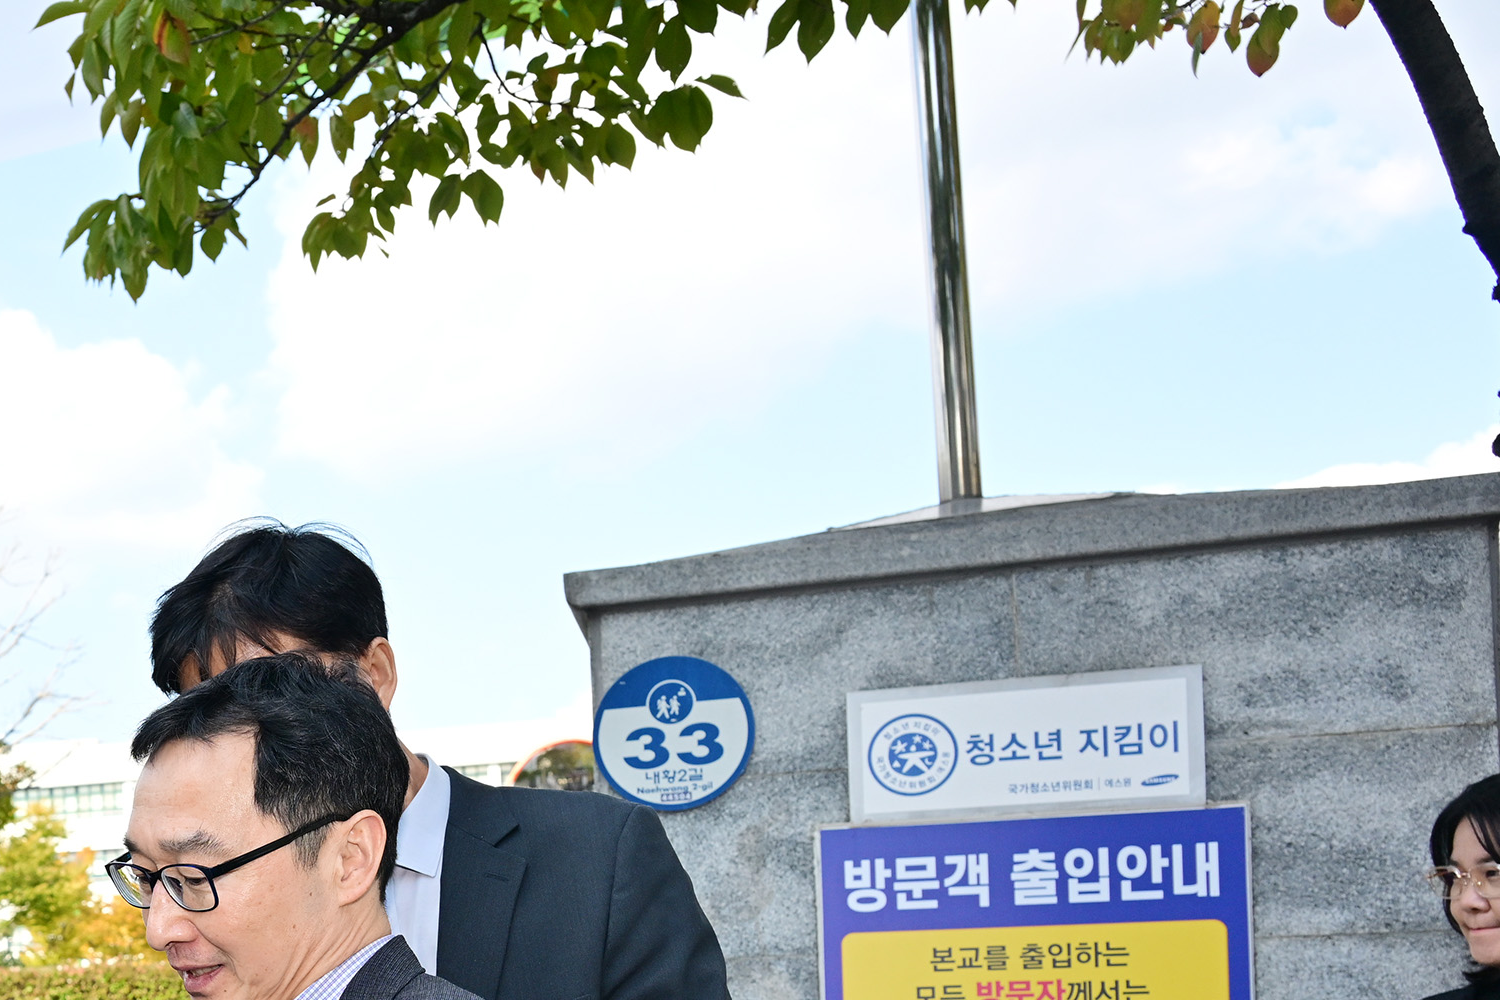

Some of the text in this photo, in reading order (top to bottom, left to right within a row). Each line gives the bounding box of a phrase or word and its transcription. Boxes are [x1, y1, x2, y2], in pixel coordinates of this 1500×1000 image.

[623, 722, 724, 770] 33
[965, 720, 1180, 767] 청소년 지킴이
[645, 768, 704, 785] 내왕2길
[1007, 777, 1132, 795] 국가청소년위원회 에스원
[843, 841, 1221, 913] 방문객 출입안내
[929, 941, 1131, 973] 본교를 출입하는
